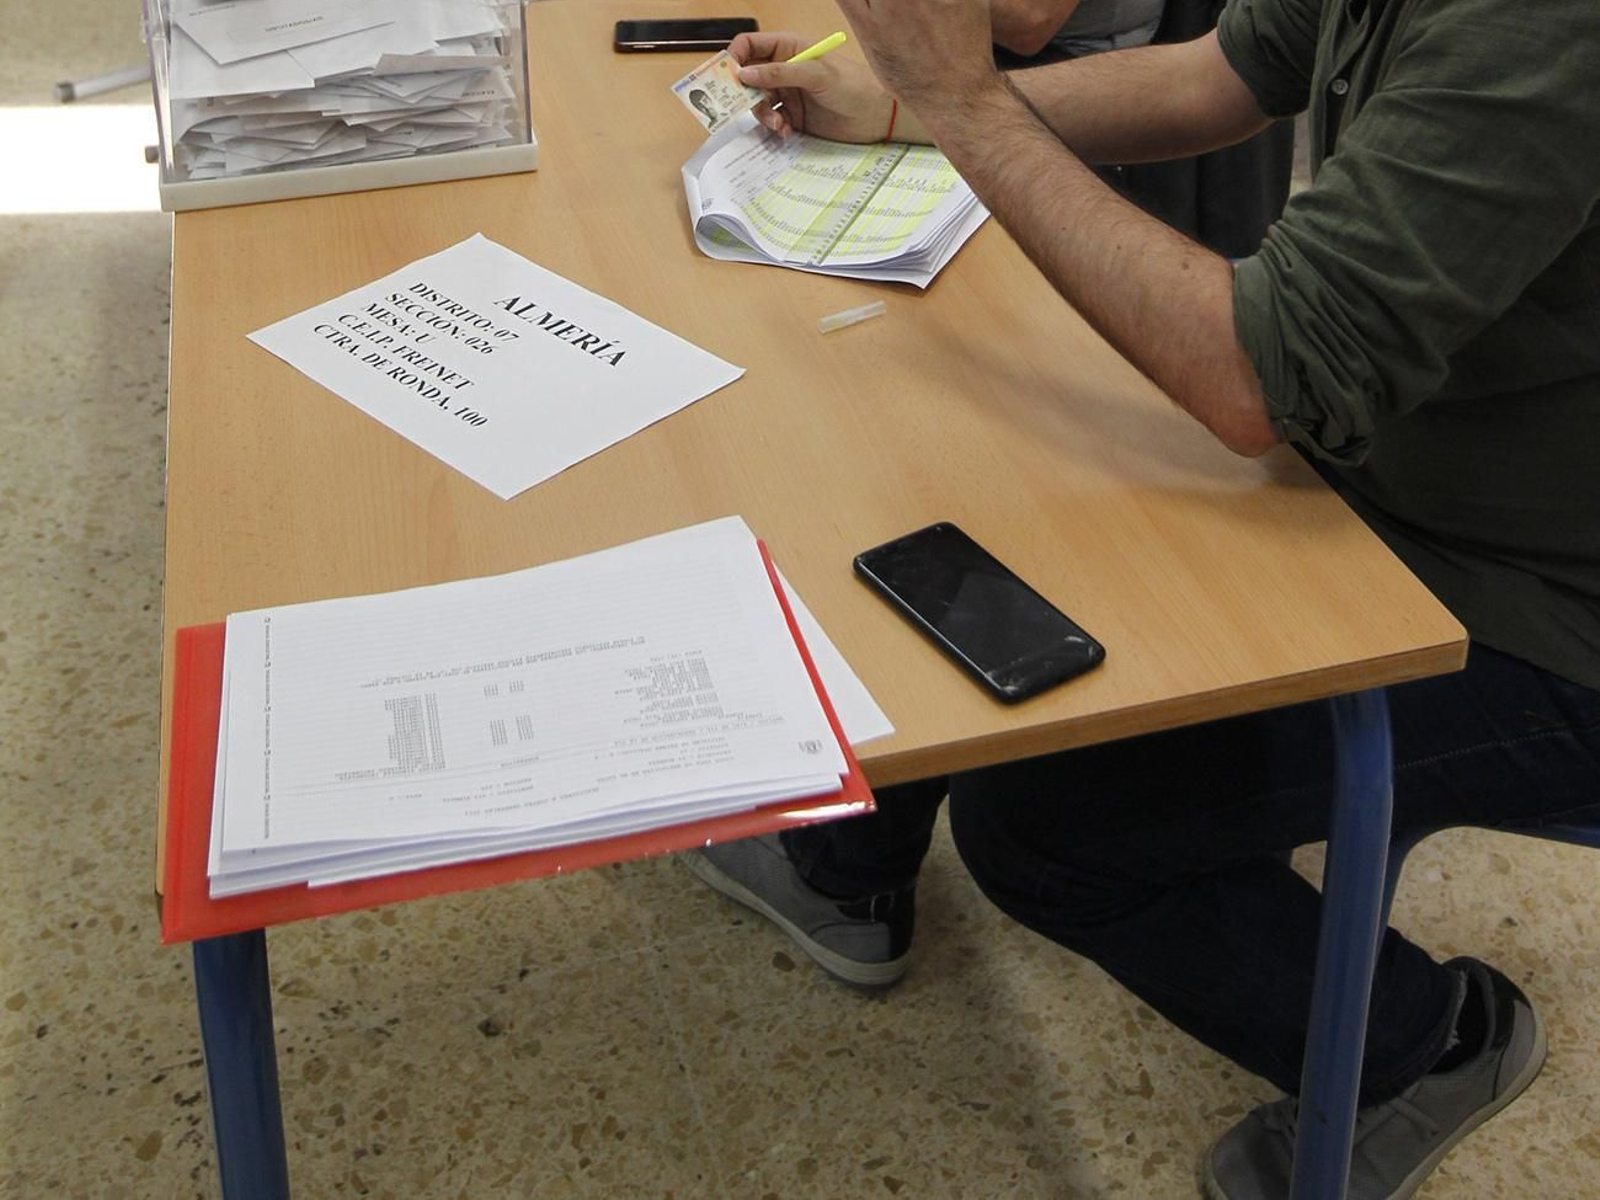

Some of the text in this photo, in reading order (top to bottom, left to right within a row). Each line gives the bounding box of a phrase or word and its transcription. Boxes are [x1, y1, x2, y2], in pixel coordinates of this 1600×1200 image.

[361, 303, 438, 345] MESA: U
[385, 292, 497, 356] SECCIÓN: 026
[408, 282, 521, 343] DISTRITO: 07
[493, 296, 627, 368] ALMERÍA
[313, 324, 360, 358] CTRA.
[361, 352, 394, 371] DE
[453, 406, 489, 428] 100
[337, 314, 476, 391] C.E.I.P. FREINET
